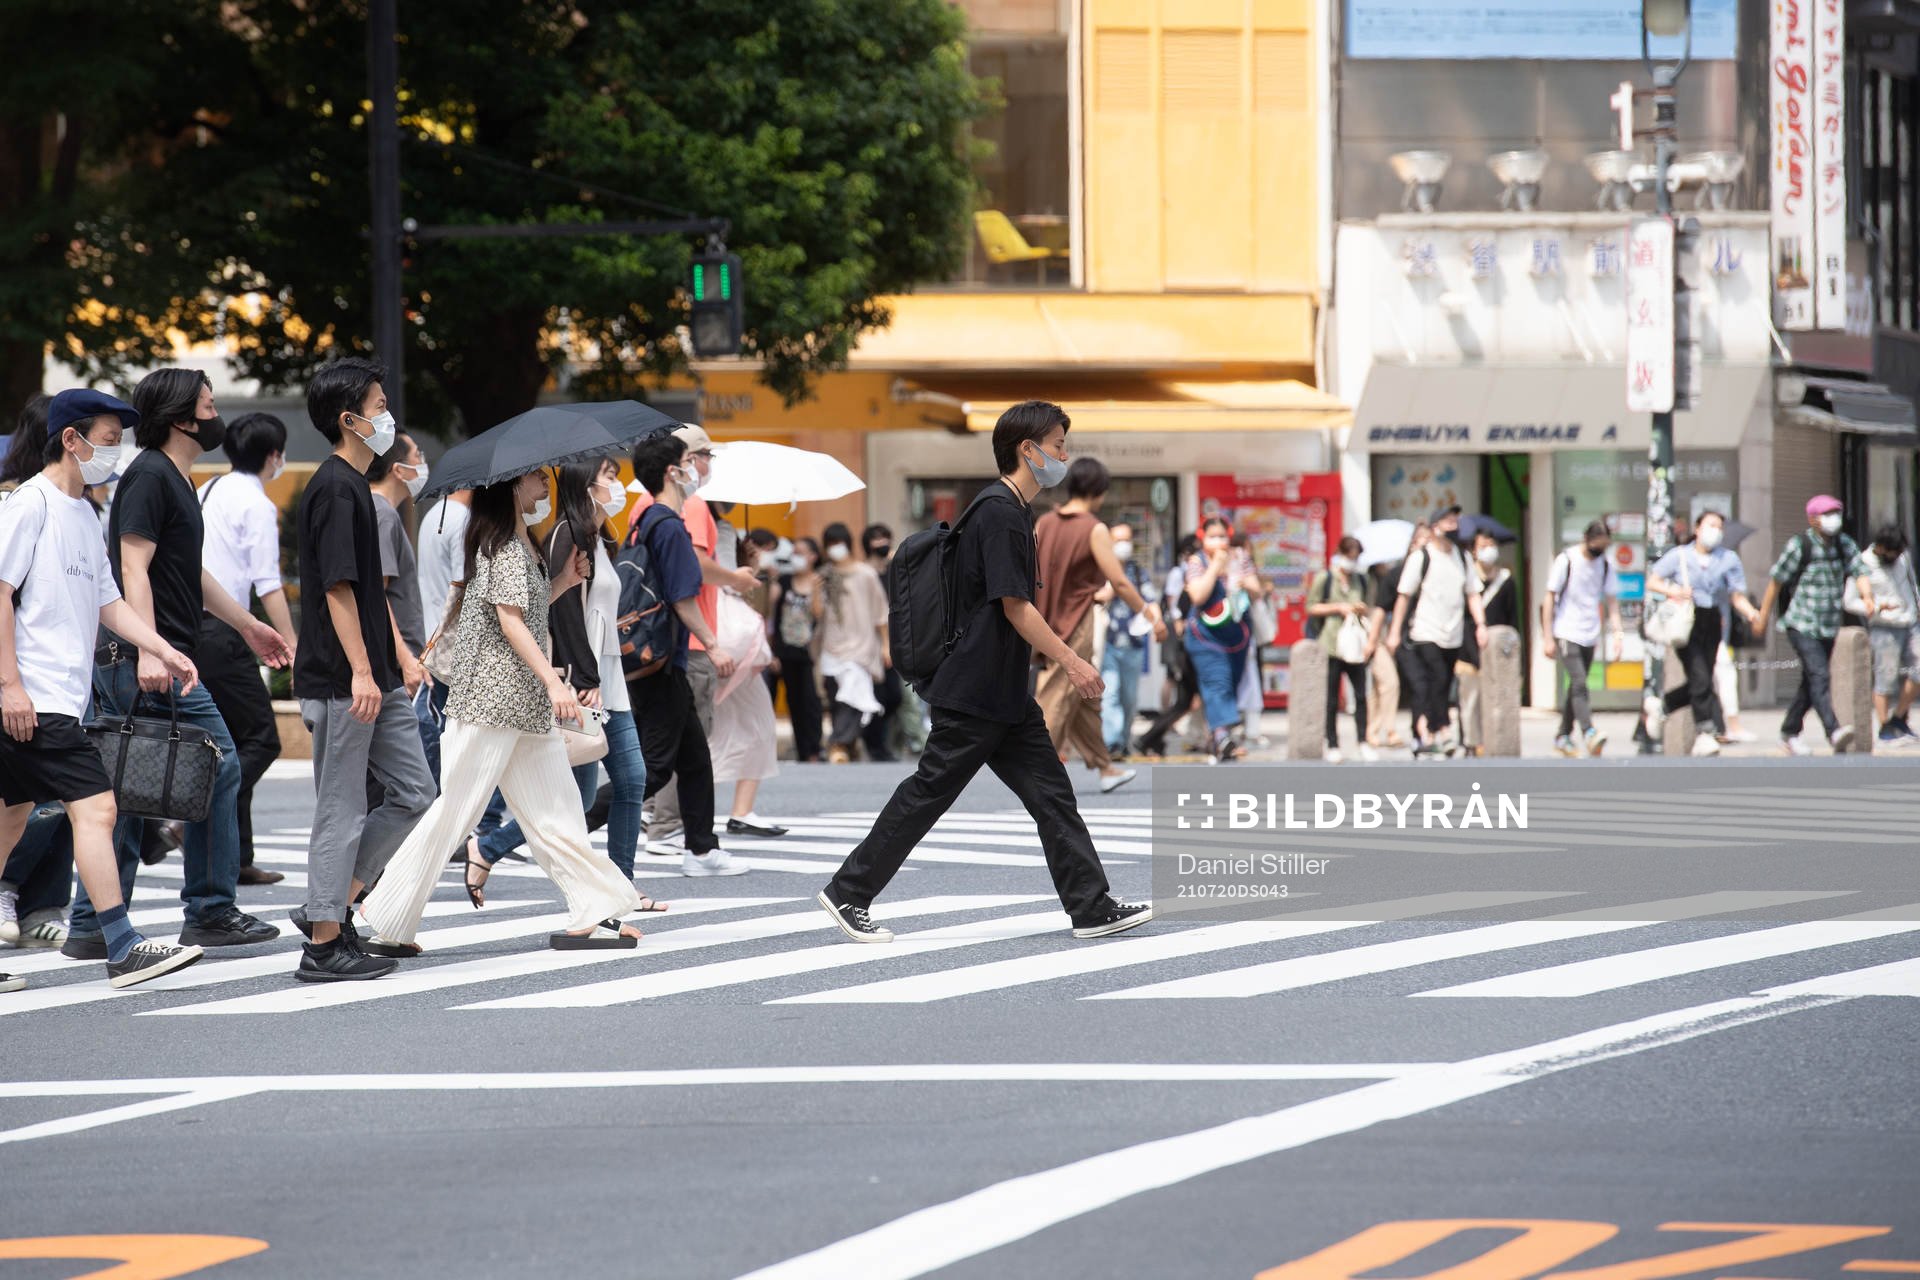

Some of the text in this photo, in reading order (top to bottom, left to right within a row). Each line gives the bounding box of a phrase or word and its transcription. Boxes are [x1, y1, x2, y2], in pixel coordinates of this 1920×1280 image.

[1402, 237, 1743, 279] 渋谷駅前ル
[1368, 424, 1470, 441] SHIBUYA
[1486, 424, 1581, 441] EKIMAE
